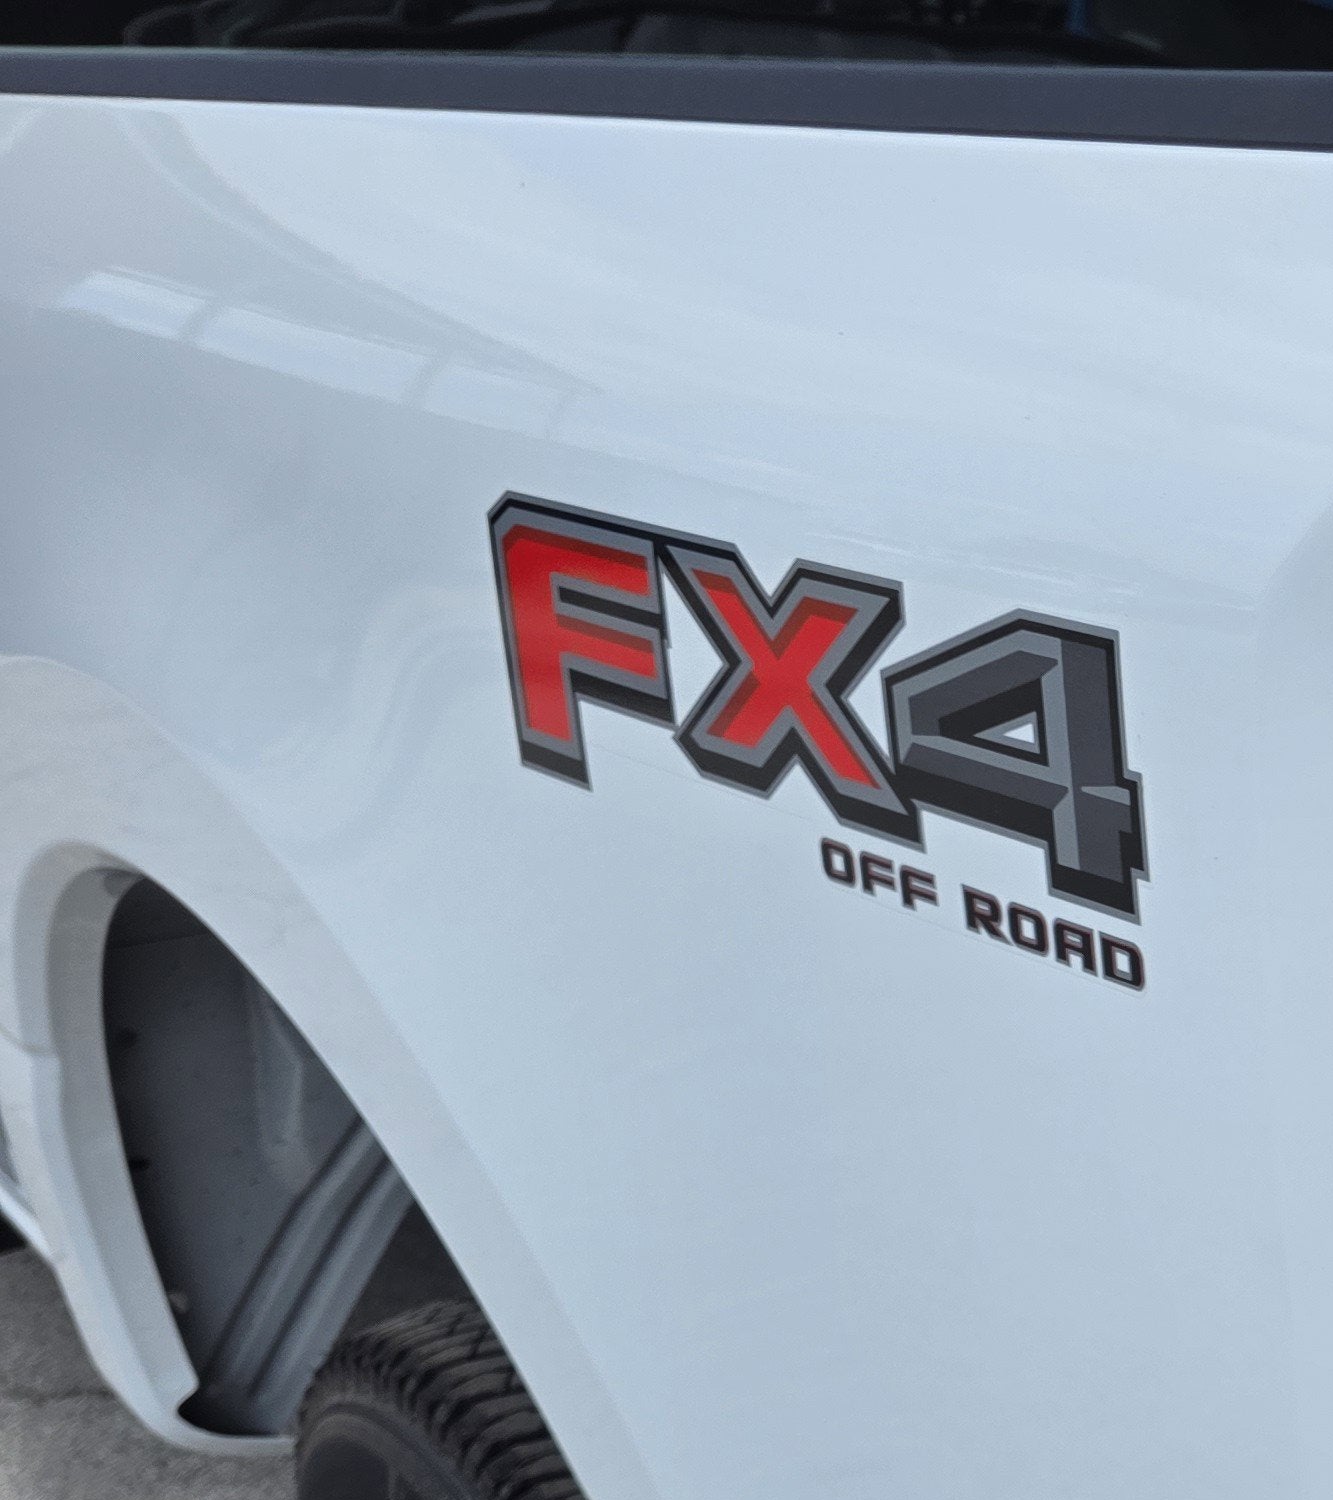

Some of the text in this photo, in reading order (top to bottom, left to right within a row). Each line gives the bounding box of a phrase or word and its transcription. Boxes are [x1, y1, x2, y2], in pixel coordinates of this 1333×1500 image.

[487, 489, 1152, 926] FX4
[820, 836, 1147, 993] OFF ROAD
